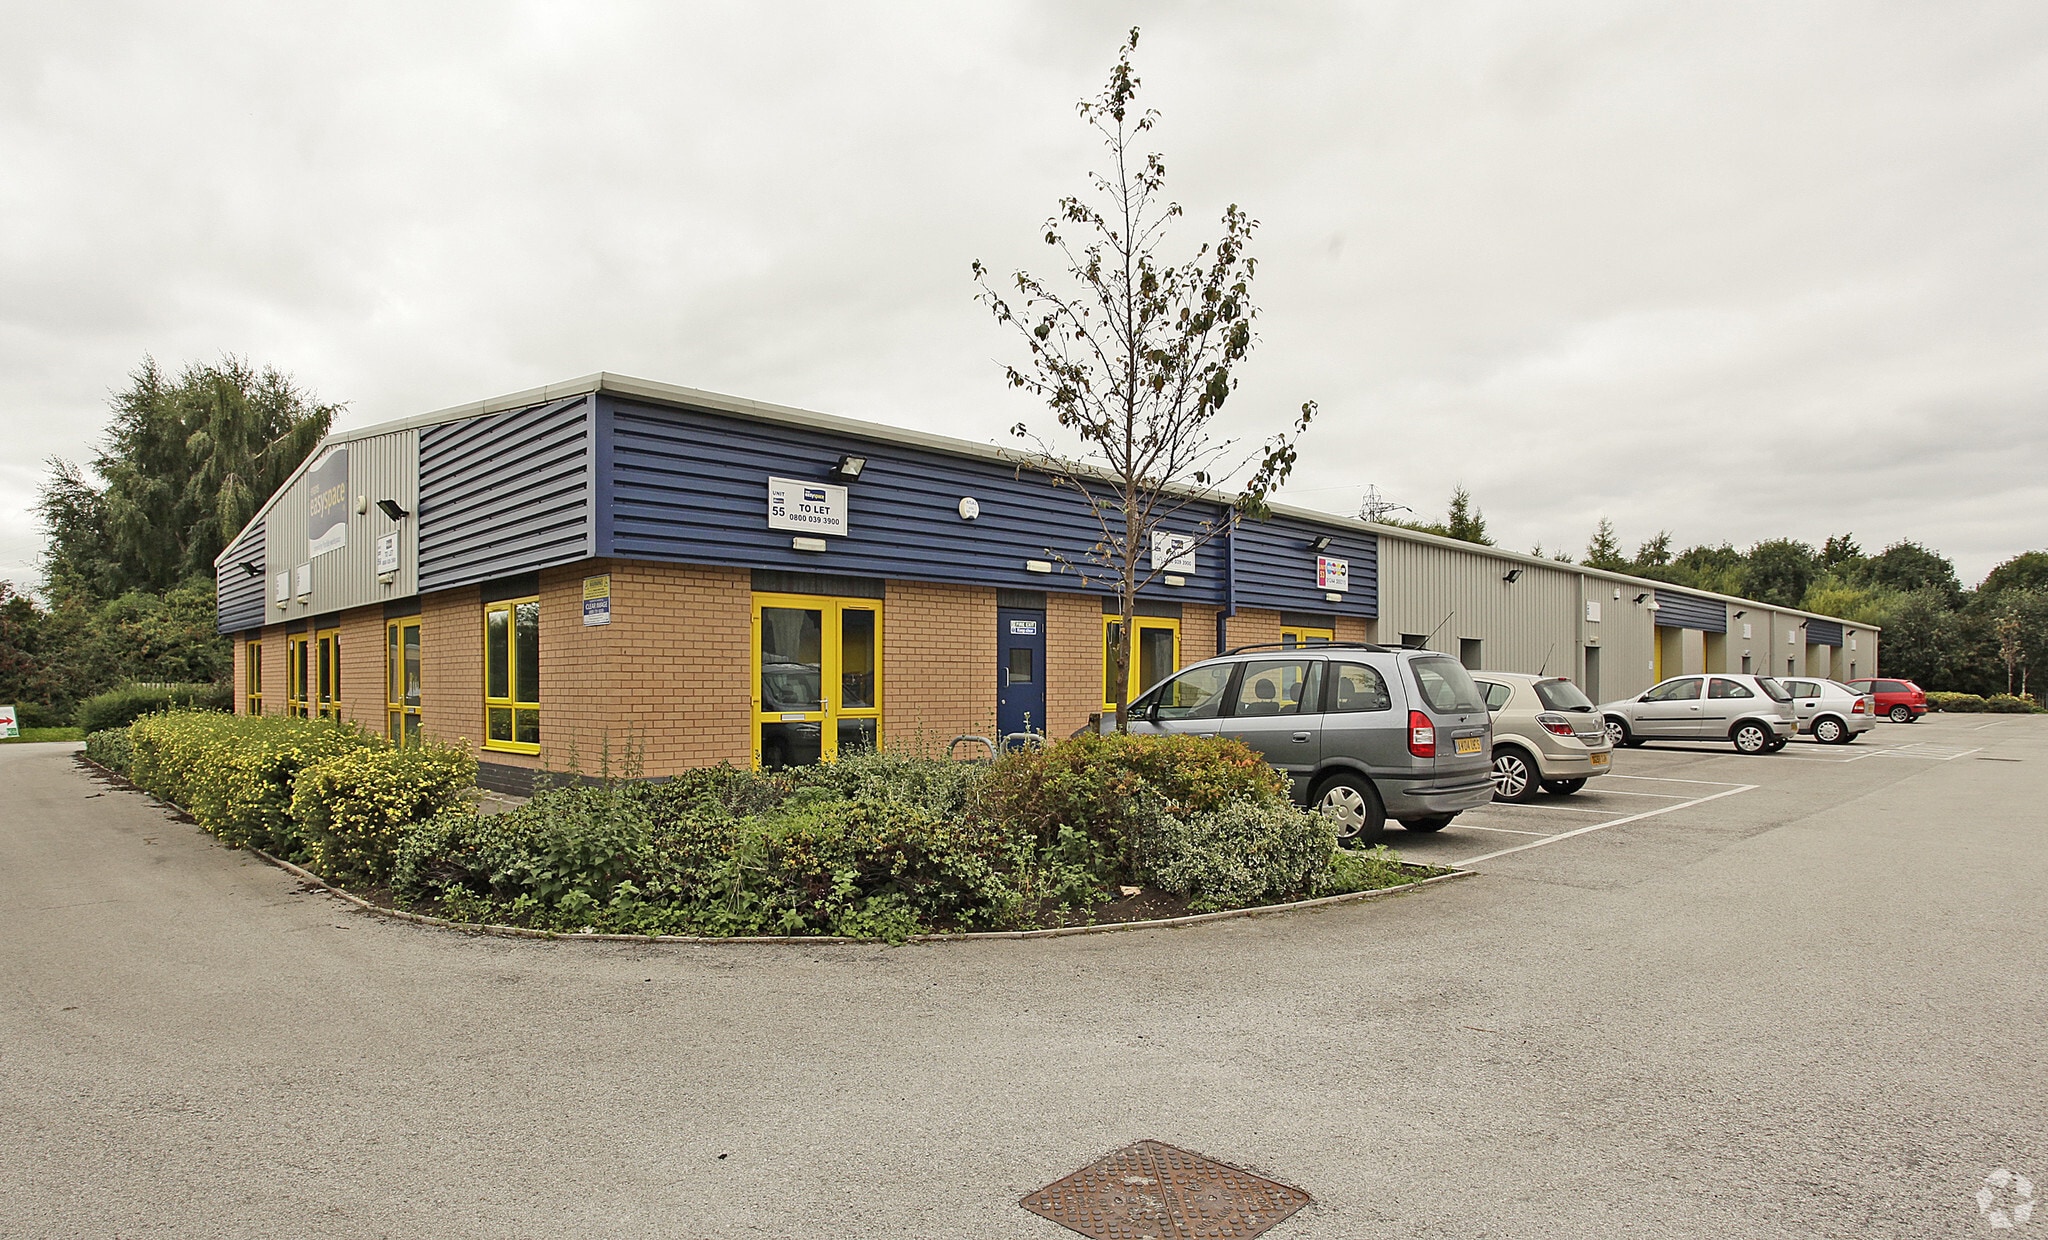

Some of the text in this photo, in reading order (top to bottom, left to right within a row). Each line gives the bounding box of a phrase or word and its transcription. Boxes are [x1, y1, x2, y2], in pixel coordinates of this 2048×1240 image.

[310, 482, 345, 518] easyspace
[772, 506, 785, 517] 55
[799, 504, 831, 515] TO LET
[789, 513, 840, 526] 0800 039 3900
